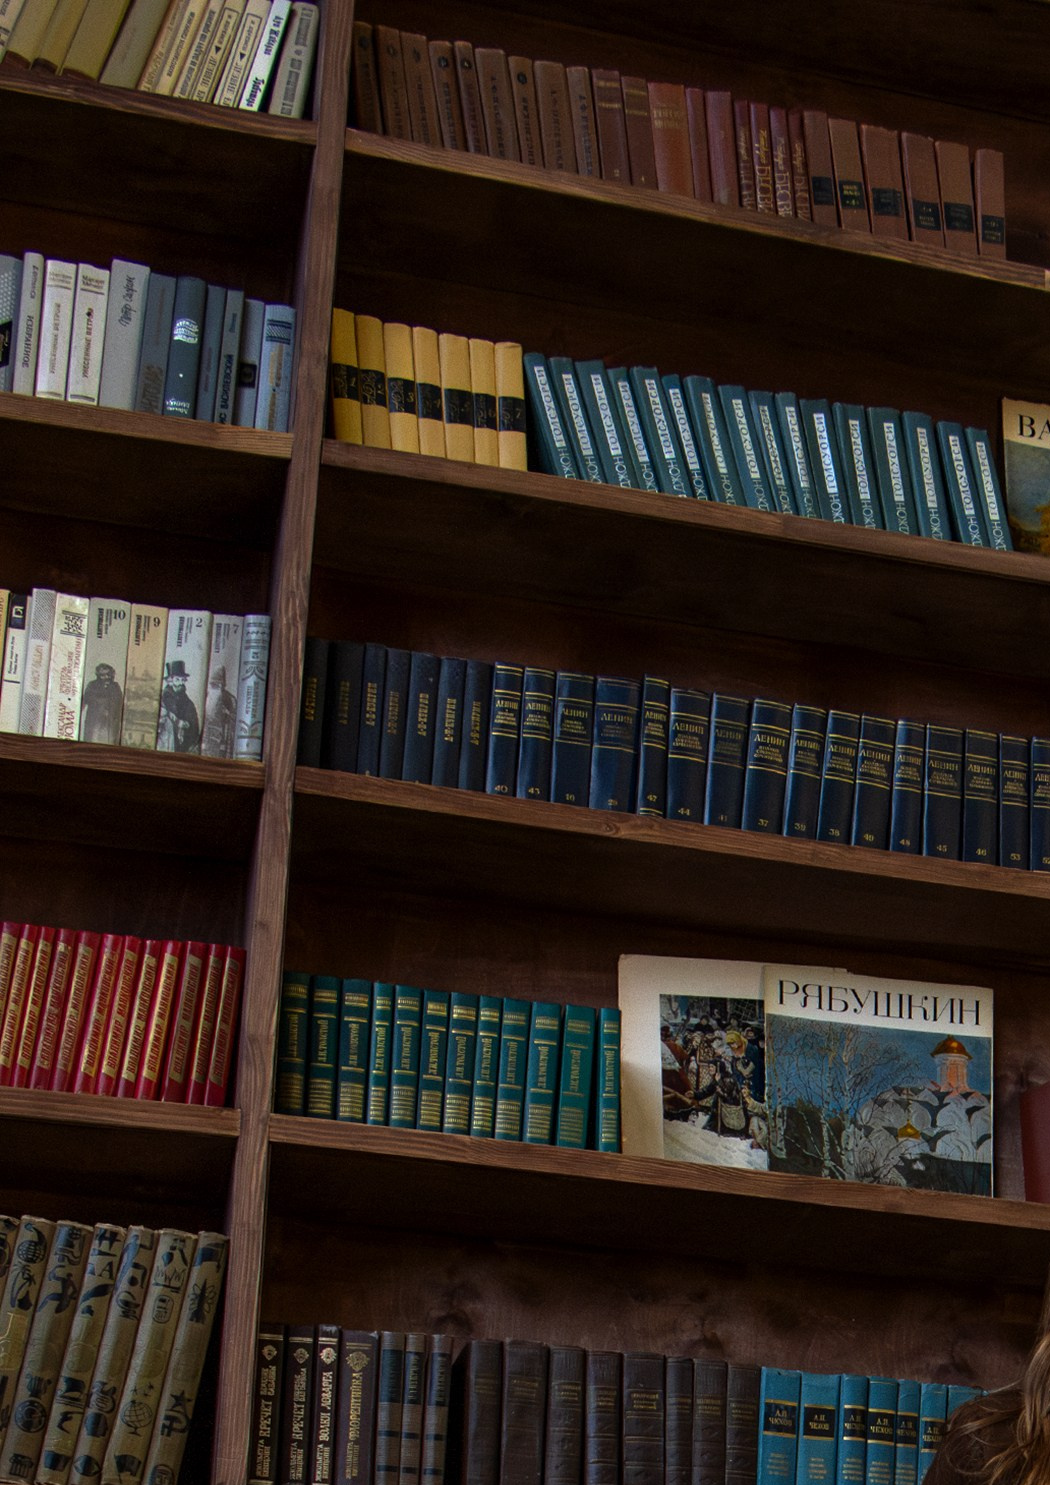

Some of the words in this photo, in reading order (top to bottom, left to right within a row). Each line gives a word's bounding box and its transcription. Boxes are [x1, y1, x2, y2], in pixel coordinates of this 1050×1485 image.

[21, 314, 34, 368] ИЗБРАННОЕ
[113, 609, 126, 620] 10
[153, 617, 161, 628] 9
[195, 618, 203, 628] 2
[232, 624, 240, 634] 7
[777, 979, 982, 1026] РЯБУШКИН
[259, 1400, 272, 1438] КРЕЧЕТ
[292, 1403, 305, 1440] КРЕЧЕТ
[318, 1408, 331, 1441] ВОЛКИ
